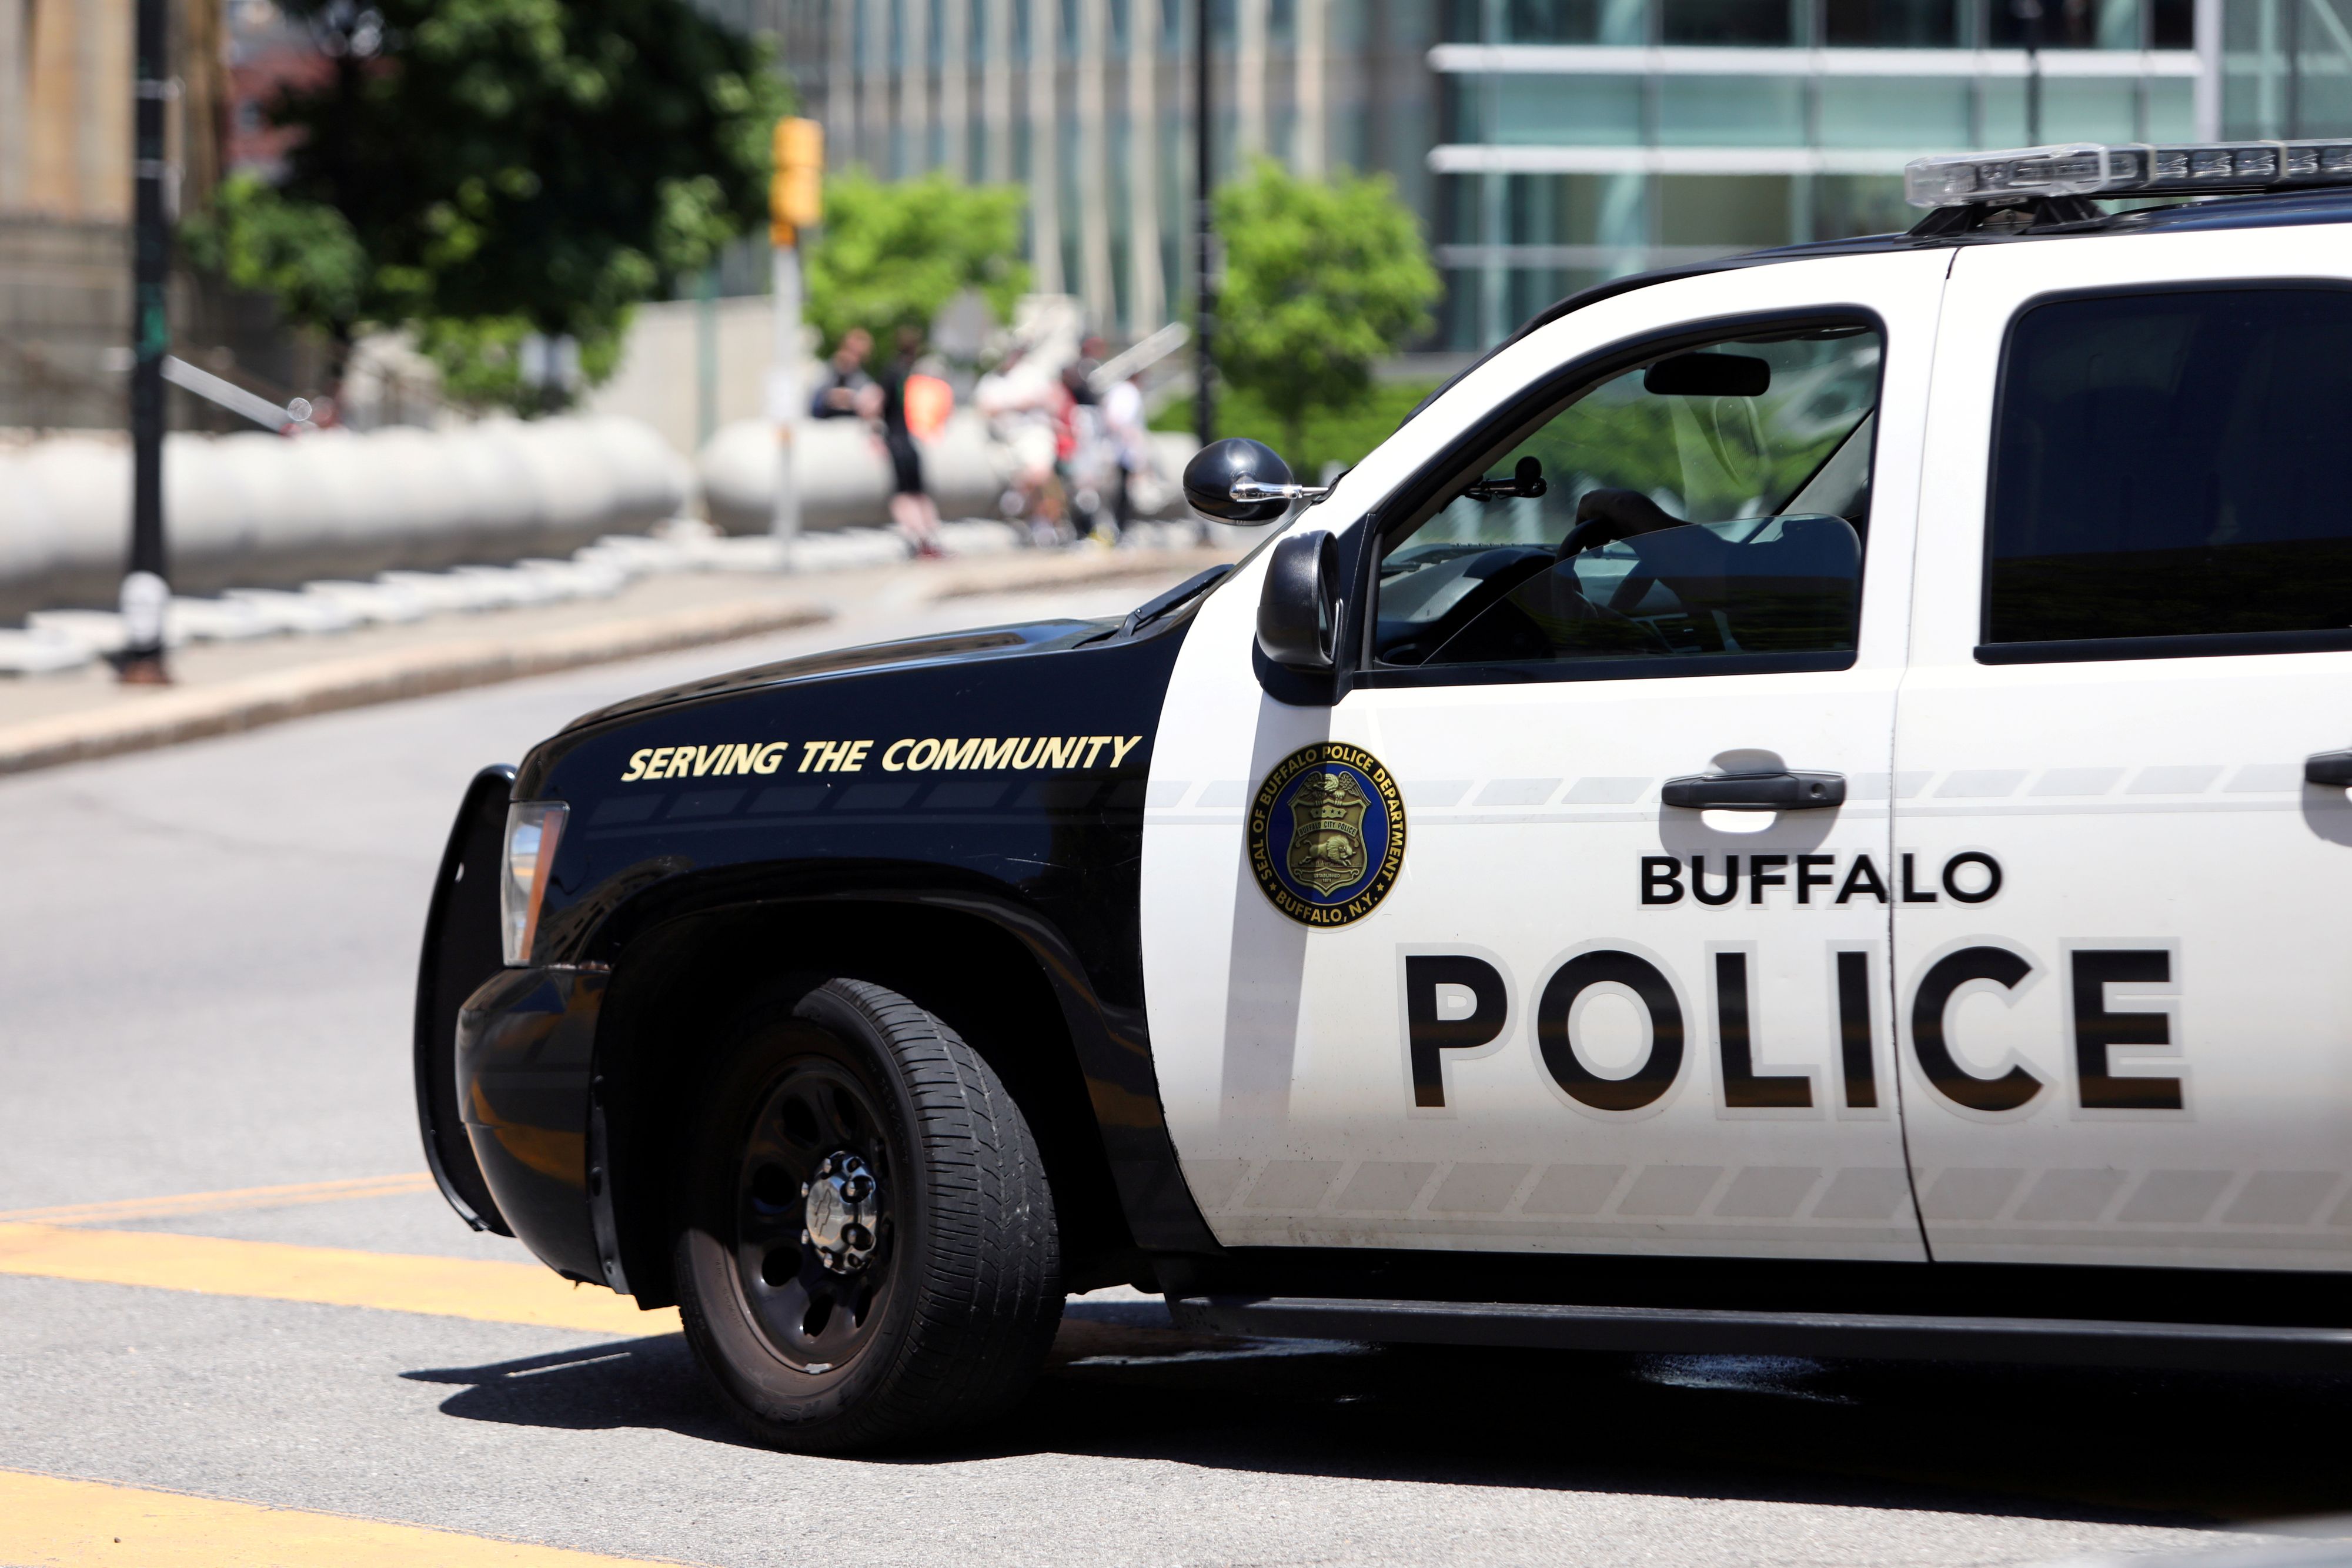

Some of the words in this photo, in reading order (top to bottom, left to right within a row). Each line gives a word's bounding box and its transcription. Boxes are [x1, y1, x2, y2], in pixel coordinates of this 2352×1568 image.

[621, 741, 789, 782] SERVING
[798, 740, 874, 773] THE
[882, 735, 1142, 771] COMMUNITY
[1259, 748, 1317, 805] BUFFALO
[1322, 745, 1374, 772] POLICE
[1252, 808, 1265, 833] OF
[1299, 821, 1321, 835] BUFFALO
[1324, 820, 1335, 828] CITY
[1338, 823, 1356, 835] POLICE
[1372, 767, 1404, 881] DEPARTMENT
[1252, 838, 1272, 881] SEAL
[1641, 851, 2003, 905] BUFFALO
[1275, 890, 1348, 923] BUFFALO,
[1349, 891, 1378, 917] N.Y.
[1406, 946, 2183, 1111] POLICE
